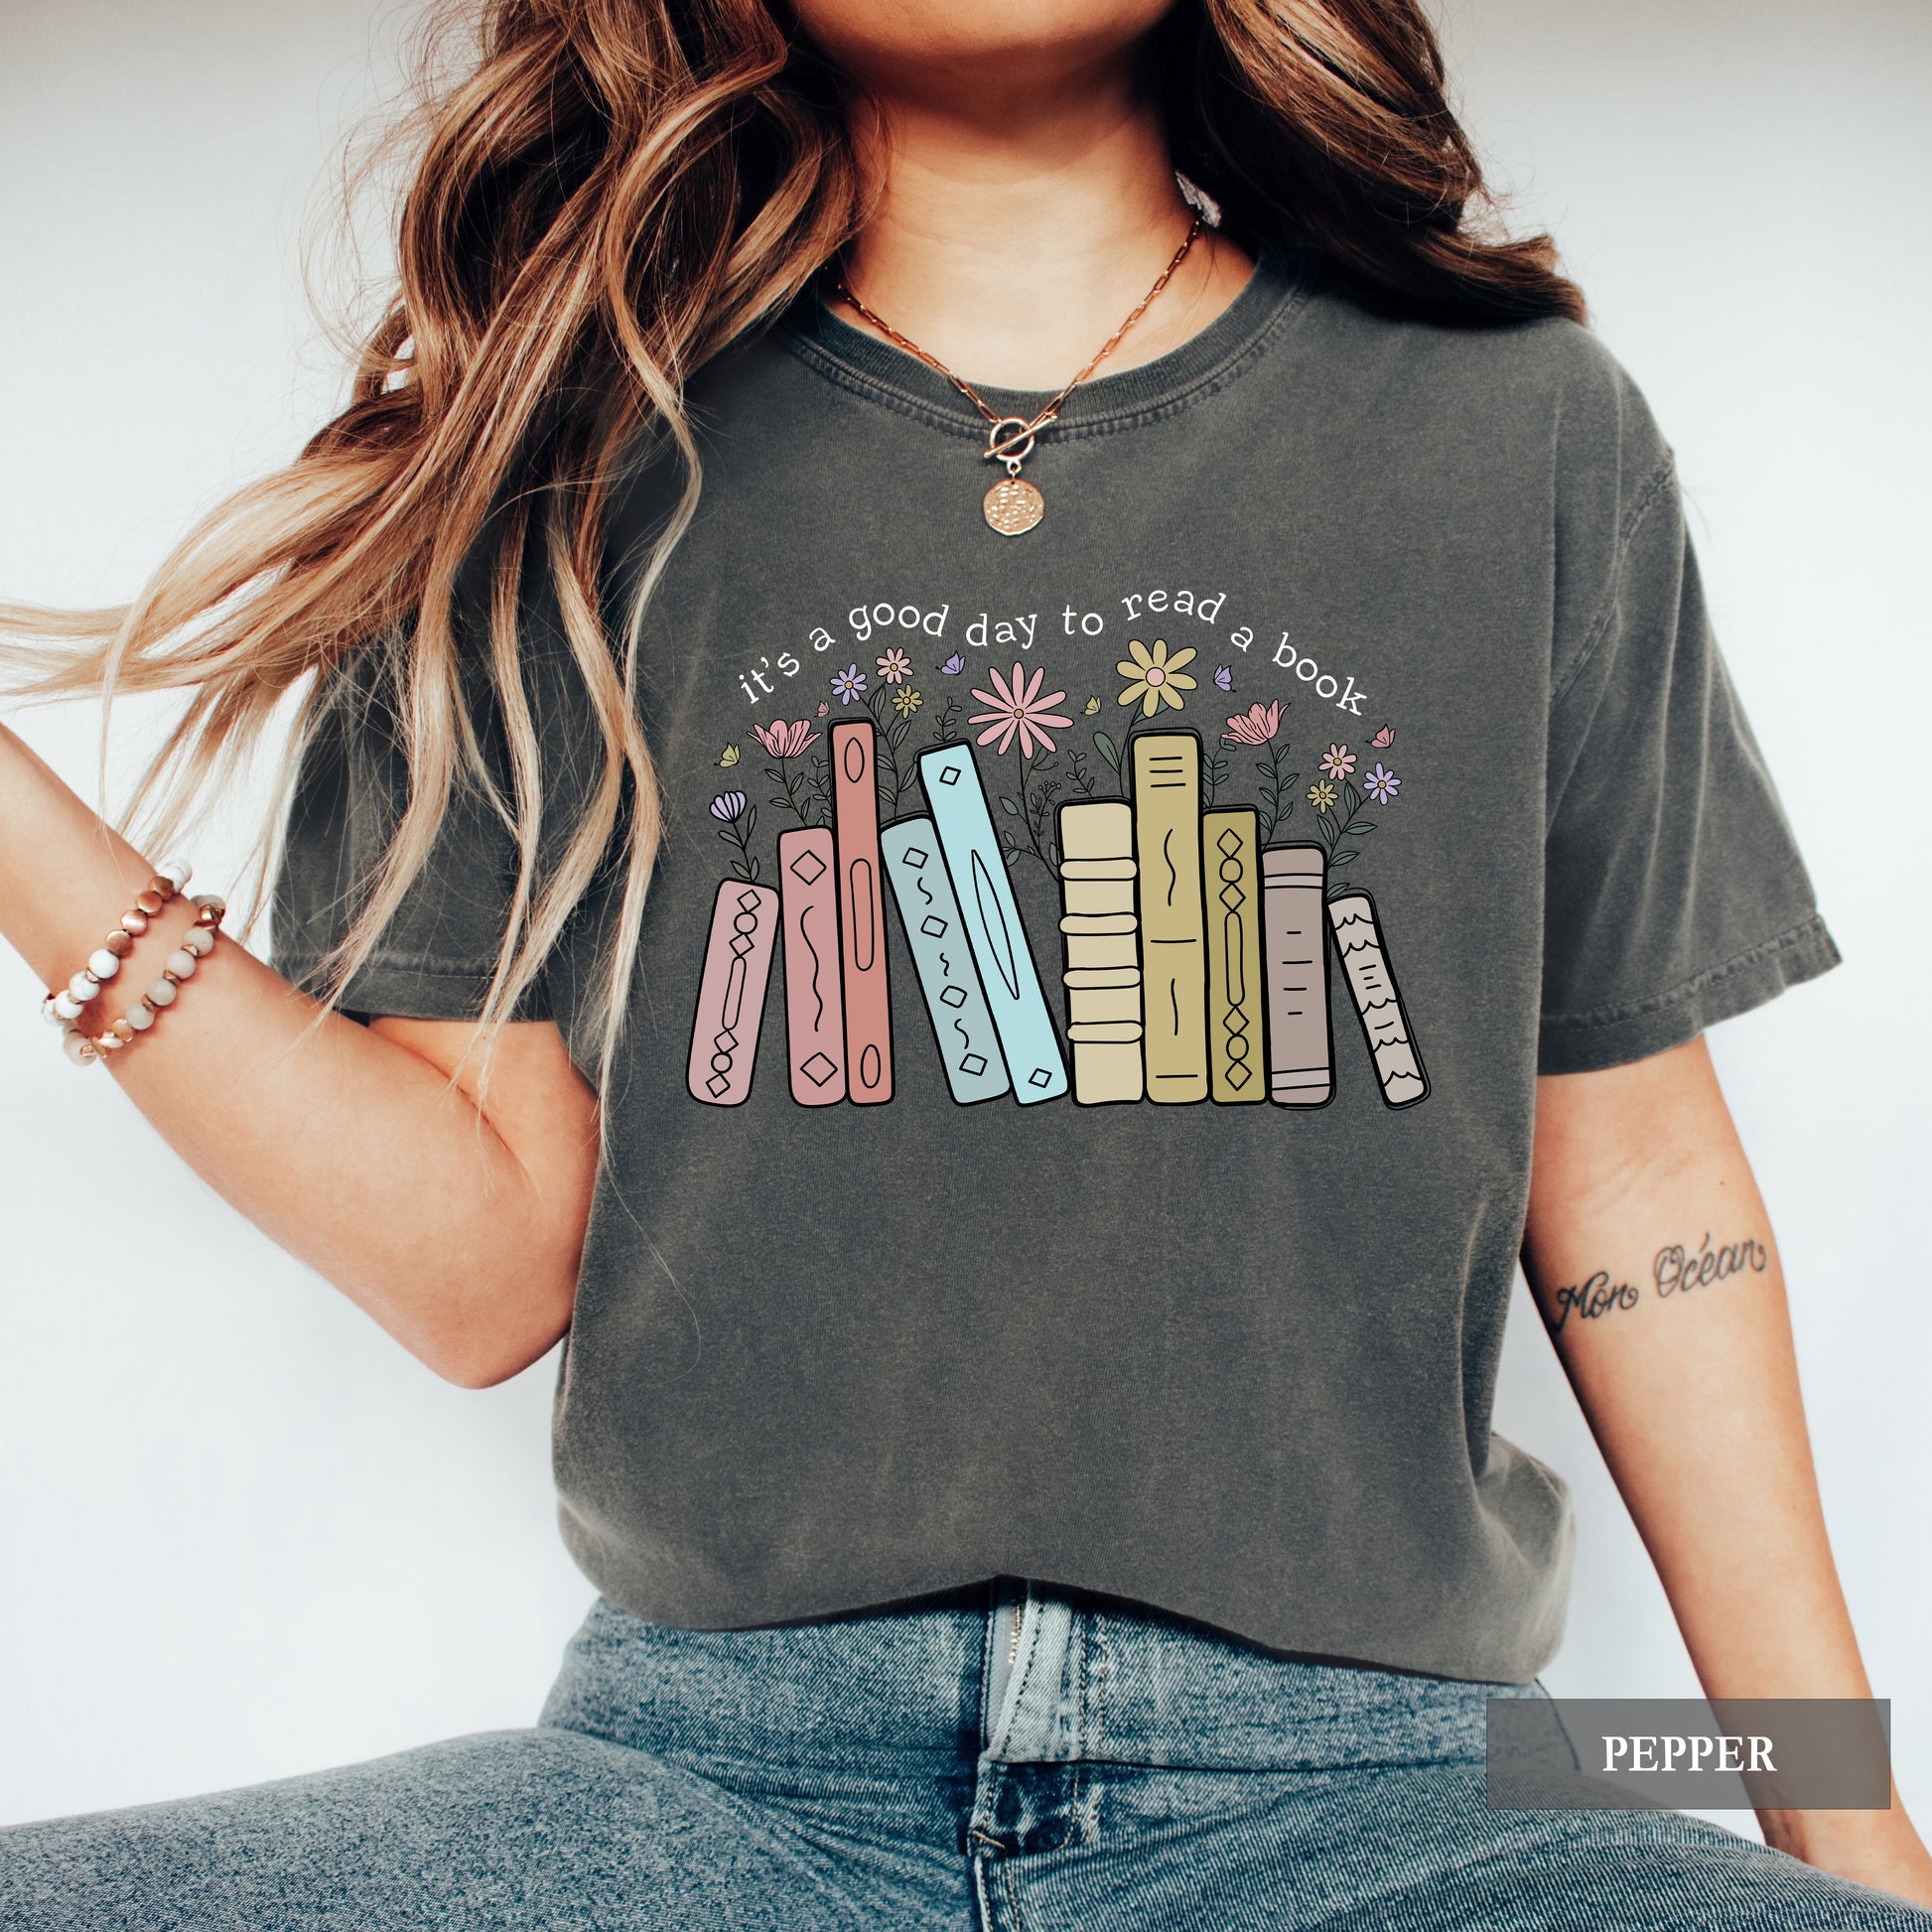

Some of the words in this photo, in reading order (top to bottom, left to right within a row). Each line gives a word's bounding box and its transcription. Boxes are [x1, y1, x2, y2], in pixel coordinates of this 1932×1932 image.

[738, 651, 800, 706] it's
[808, 626, 836, 652] a
[848, 603, 949, 641] good
[965, 613, 1038, 650] day
[1061, 604, 1104, 636] to
[1121, 590, 1227, 624] read
[1230, 626, 1254, 653] a
[1272, 631, 1368, 716] book
[1556, 1271, 1640, 1332] Mon
[1653, 1231, 1767, 1298] Océan
